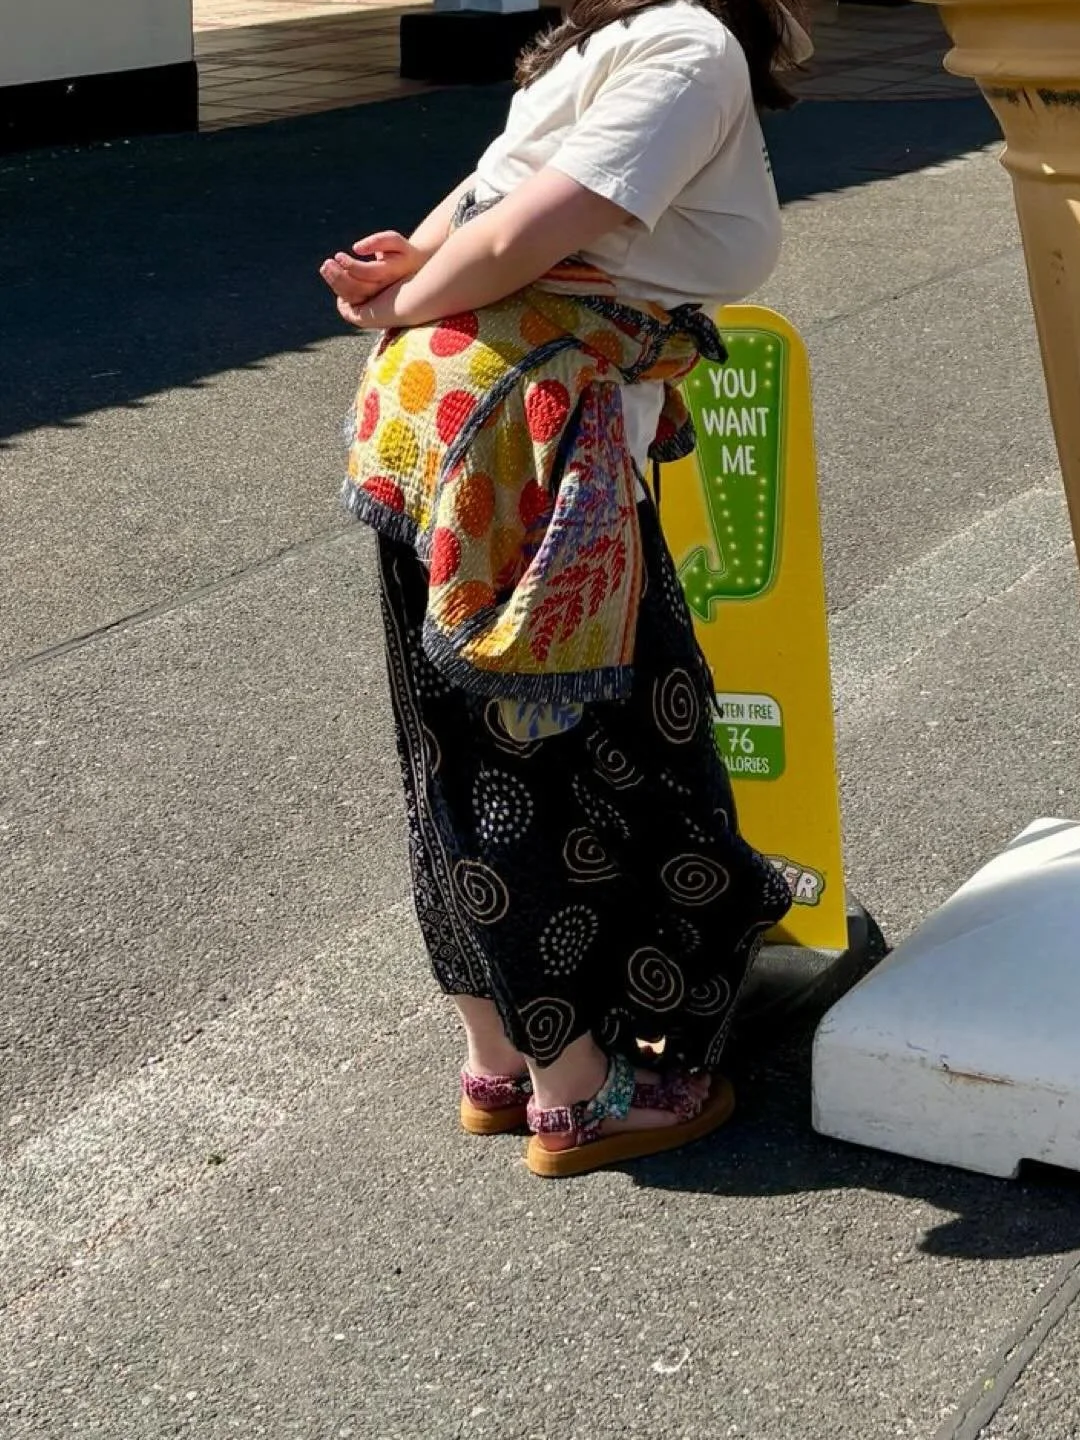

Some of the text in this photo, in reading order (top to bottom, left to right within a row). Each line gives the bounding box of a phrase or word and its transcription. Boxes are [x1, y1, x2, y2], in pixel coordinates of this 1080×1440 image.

[708, 367, 756, 399] YOU
[702, 407, 770, 437] WANT
[721, 443, 757, 476] ME
[748, 703, 774, 720] FREE
[727, 726, 754, 753] 76
[723, 755, 770, 774] ALORIES
